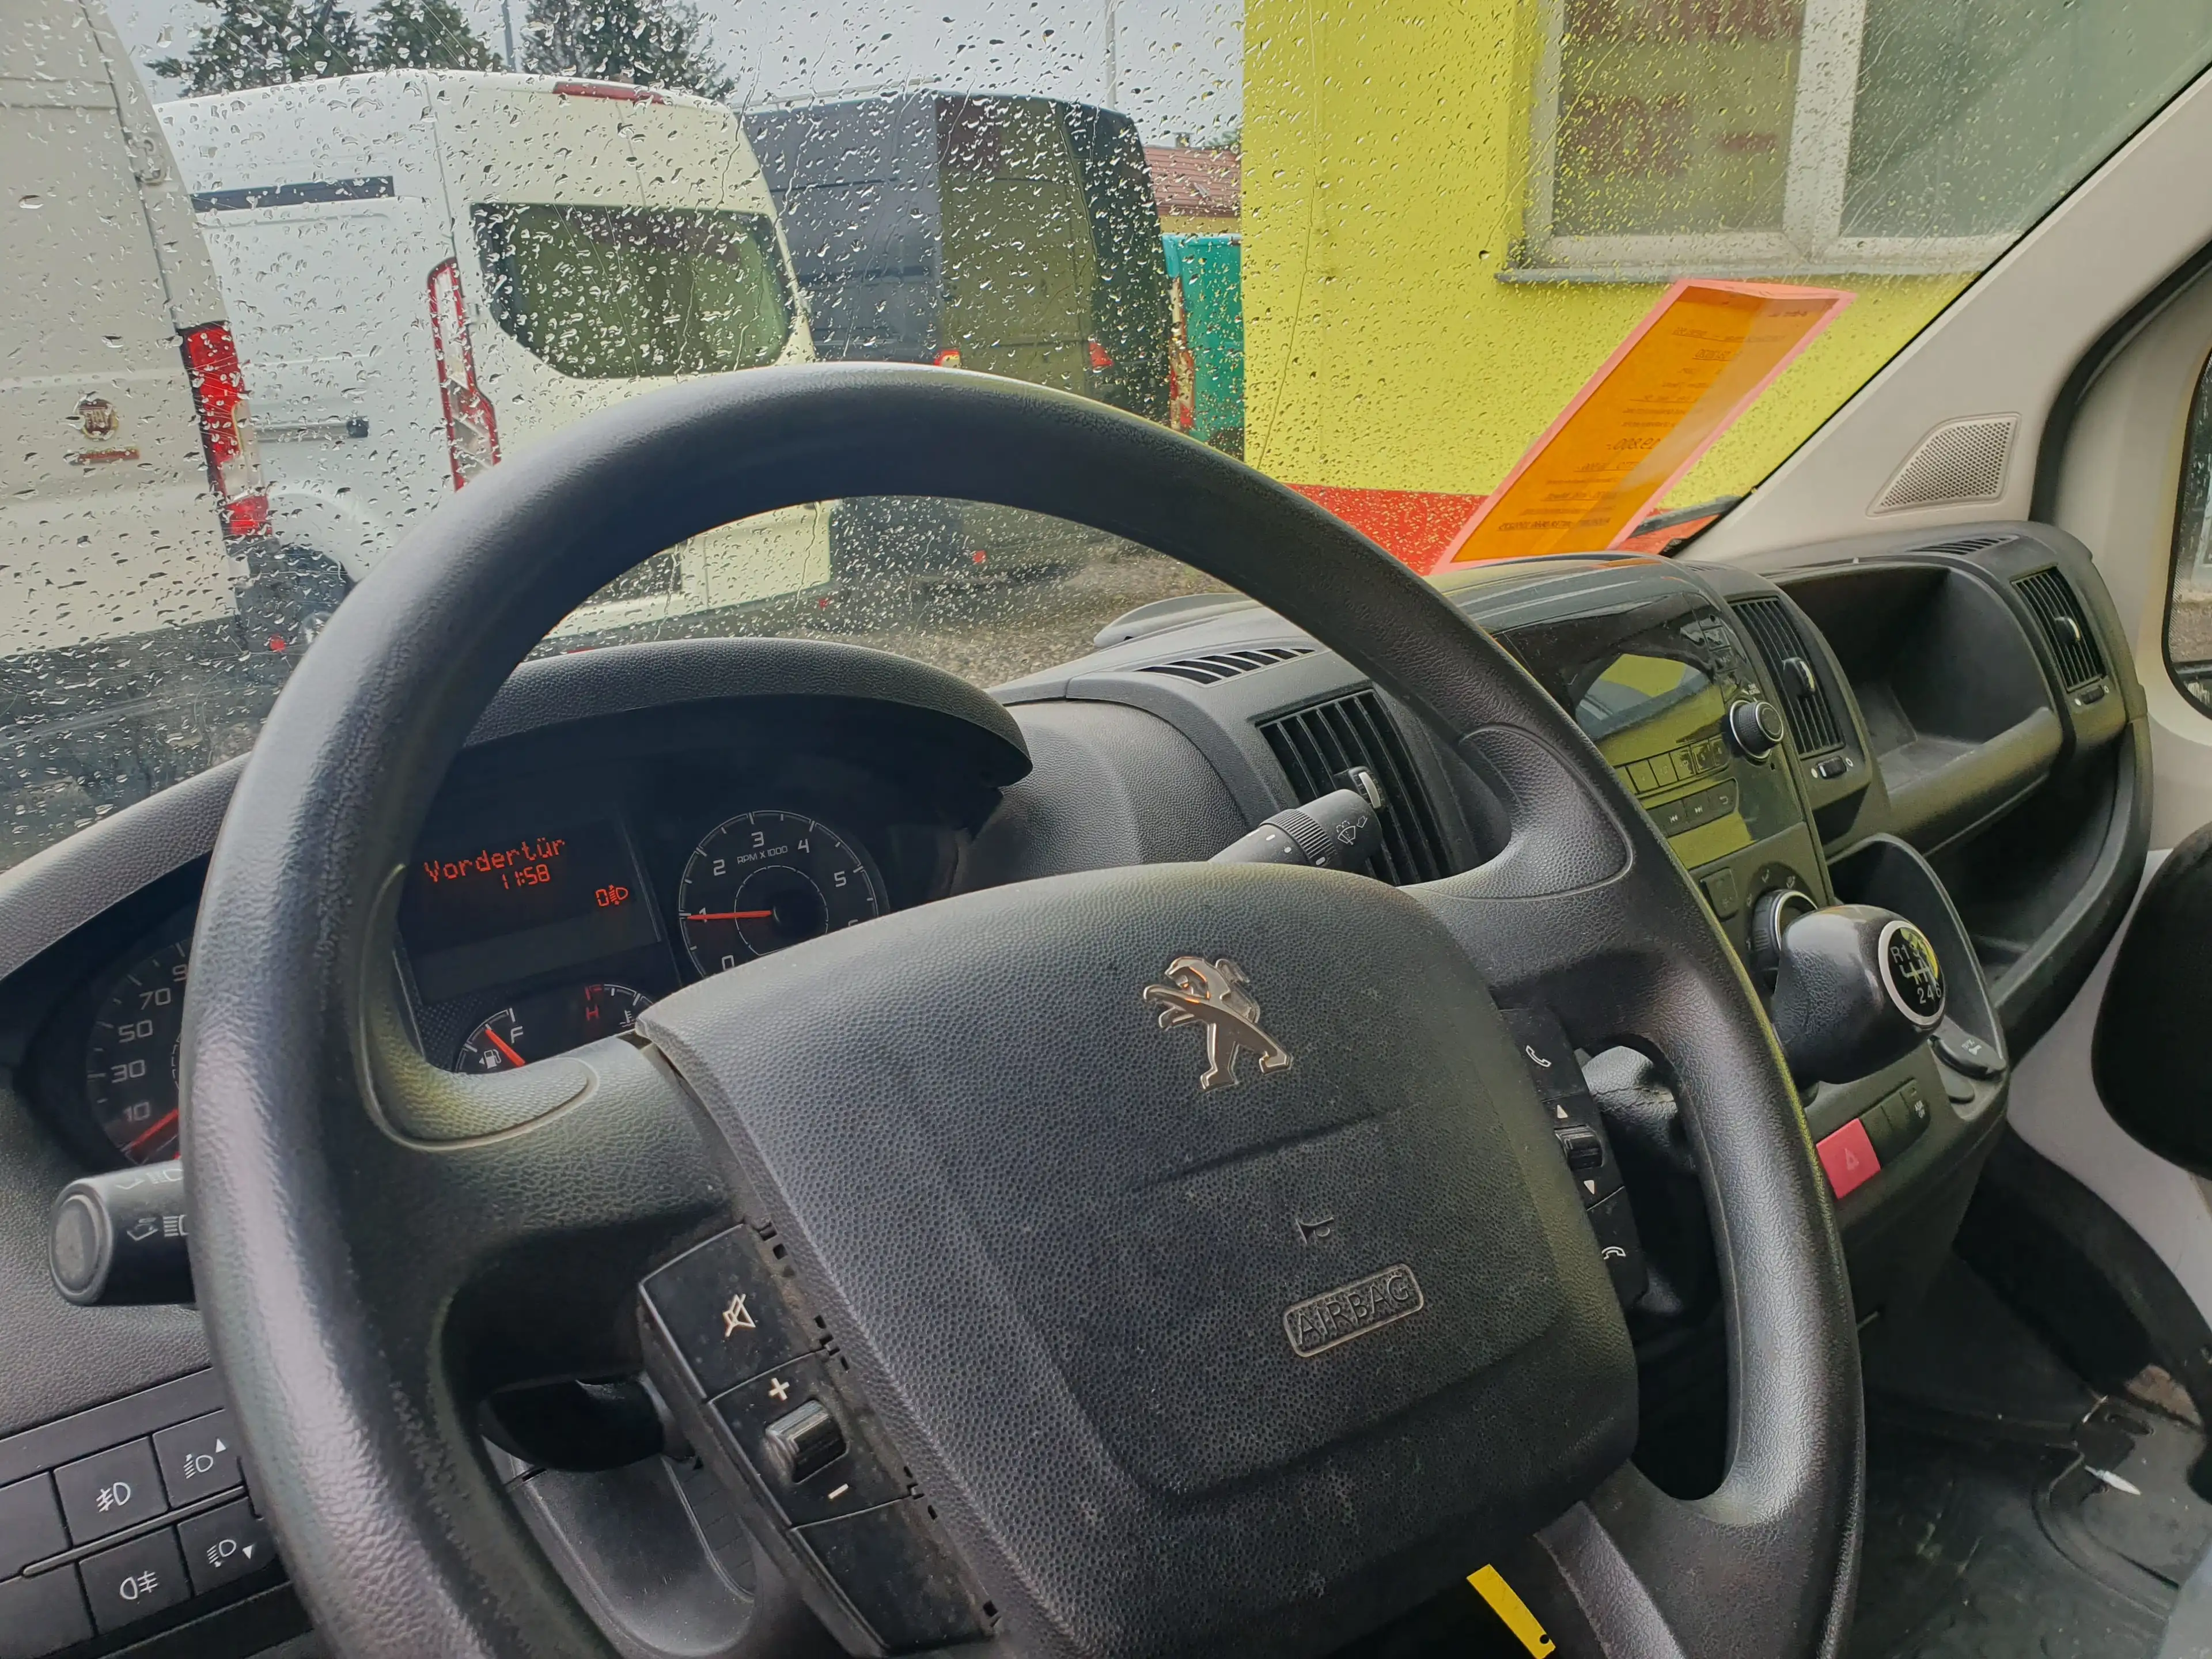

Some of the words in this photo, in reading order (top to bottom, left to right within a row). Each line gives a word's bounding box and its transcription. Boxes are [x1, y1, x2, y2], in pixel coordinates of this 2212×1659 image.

[751, 831, 764, 848] 3
[798, 839, 810, 854] 4
[424, 837, 565, 882] Vordertür
[737, 853, 757, 865] RPM
[768, 845, 789, 858] 1000
[502, 863, 551, 889] 11:58
[713, 859, 726, 876] 2
[834, 871, 847, 887] 5
[1890, 946, 1903, 963] R
[139, 987, 172, 1010] 70
[1917, 987, 1927, 1004] 2
[586, 1004, 600, 1021] H
[118, 1020, 153, 1043] 50
[510, 1025, 523, 1044] F
[110, 1059, 146, 1083] 30
[123, 1101, 150, 1122] 10
[1295, 1273, 1410, 1345] AIRBAG
